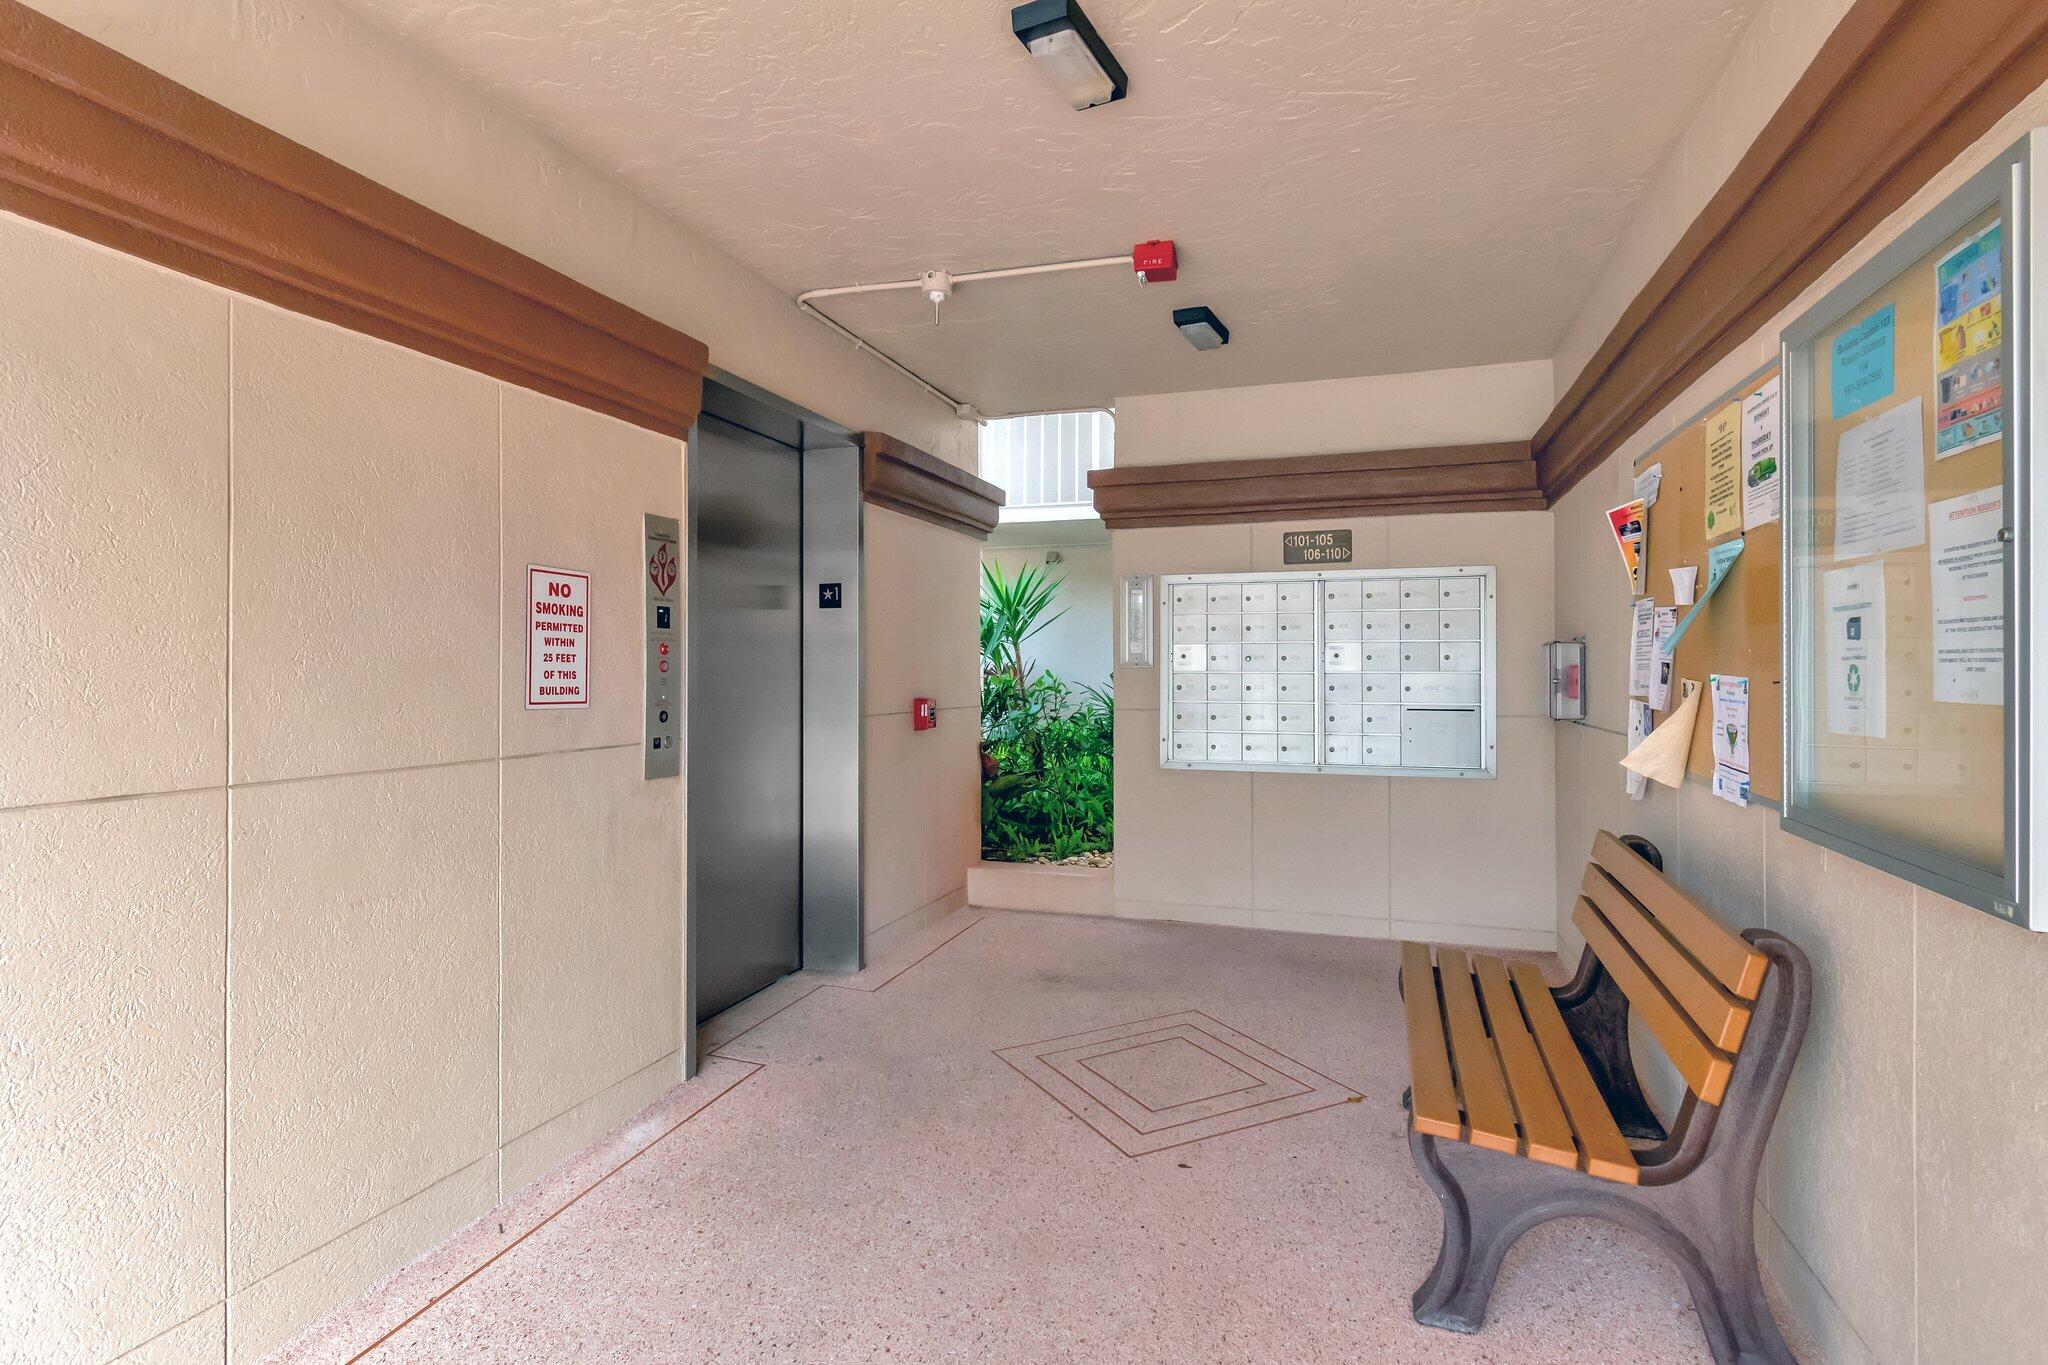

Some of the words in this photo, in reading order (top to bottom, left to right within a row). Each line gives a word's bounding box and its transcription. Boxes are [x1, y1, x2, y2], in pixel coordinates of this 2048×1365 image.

[1948, 507, 1977, 520] ATTENTION
[1293, 534, 1333, 546] 101-105
[1303, 547, 1341, 560] 106-110
[548, 582, 572, 598] NO
[535, 601, 584, 618] SMOKING
[535, 621, 584, 633] PERMITTED
[544, 637, 575, 648] WITHIN
[543, 653, 553, 662] 25
[556, 654, 576, 663] FEET
[543, 670, 555, 679] OF
[557, 670, 577, 680] THIS
[539, 686, 580, 695] BUILDING
